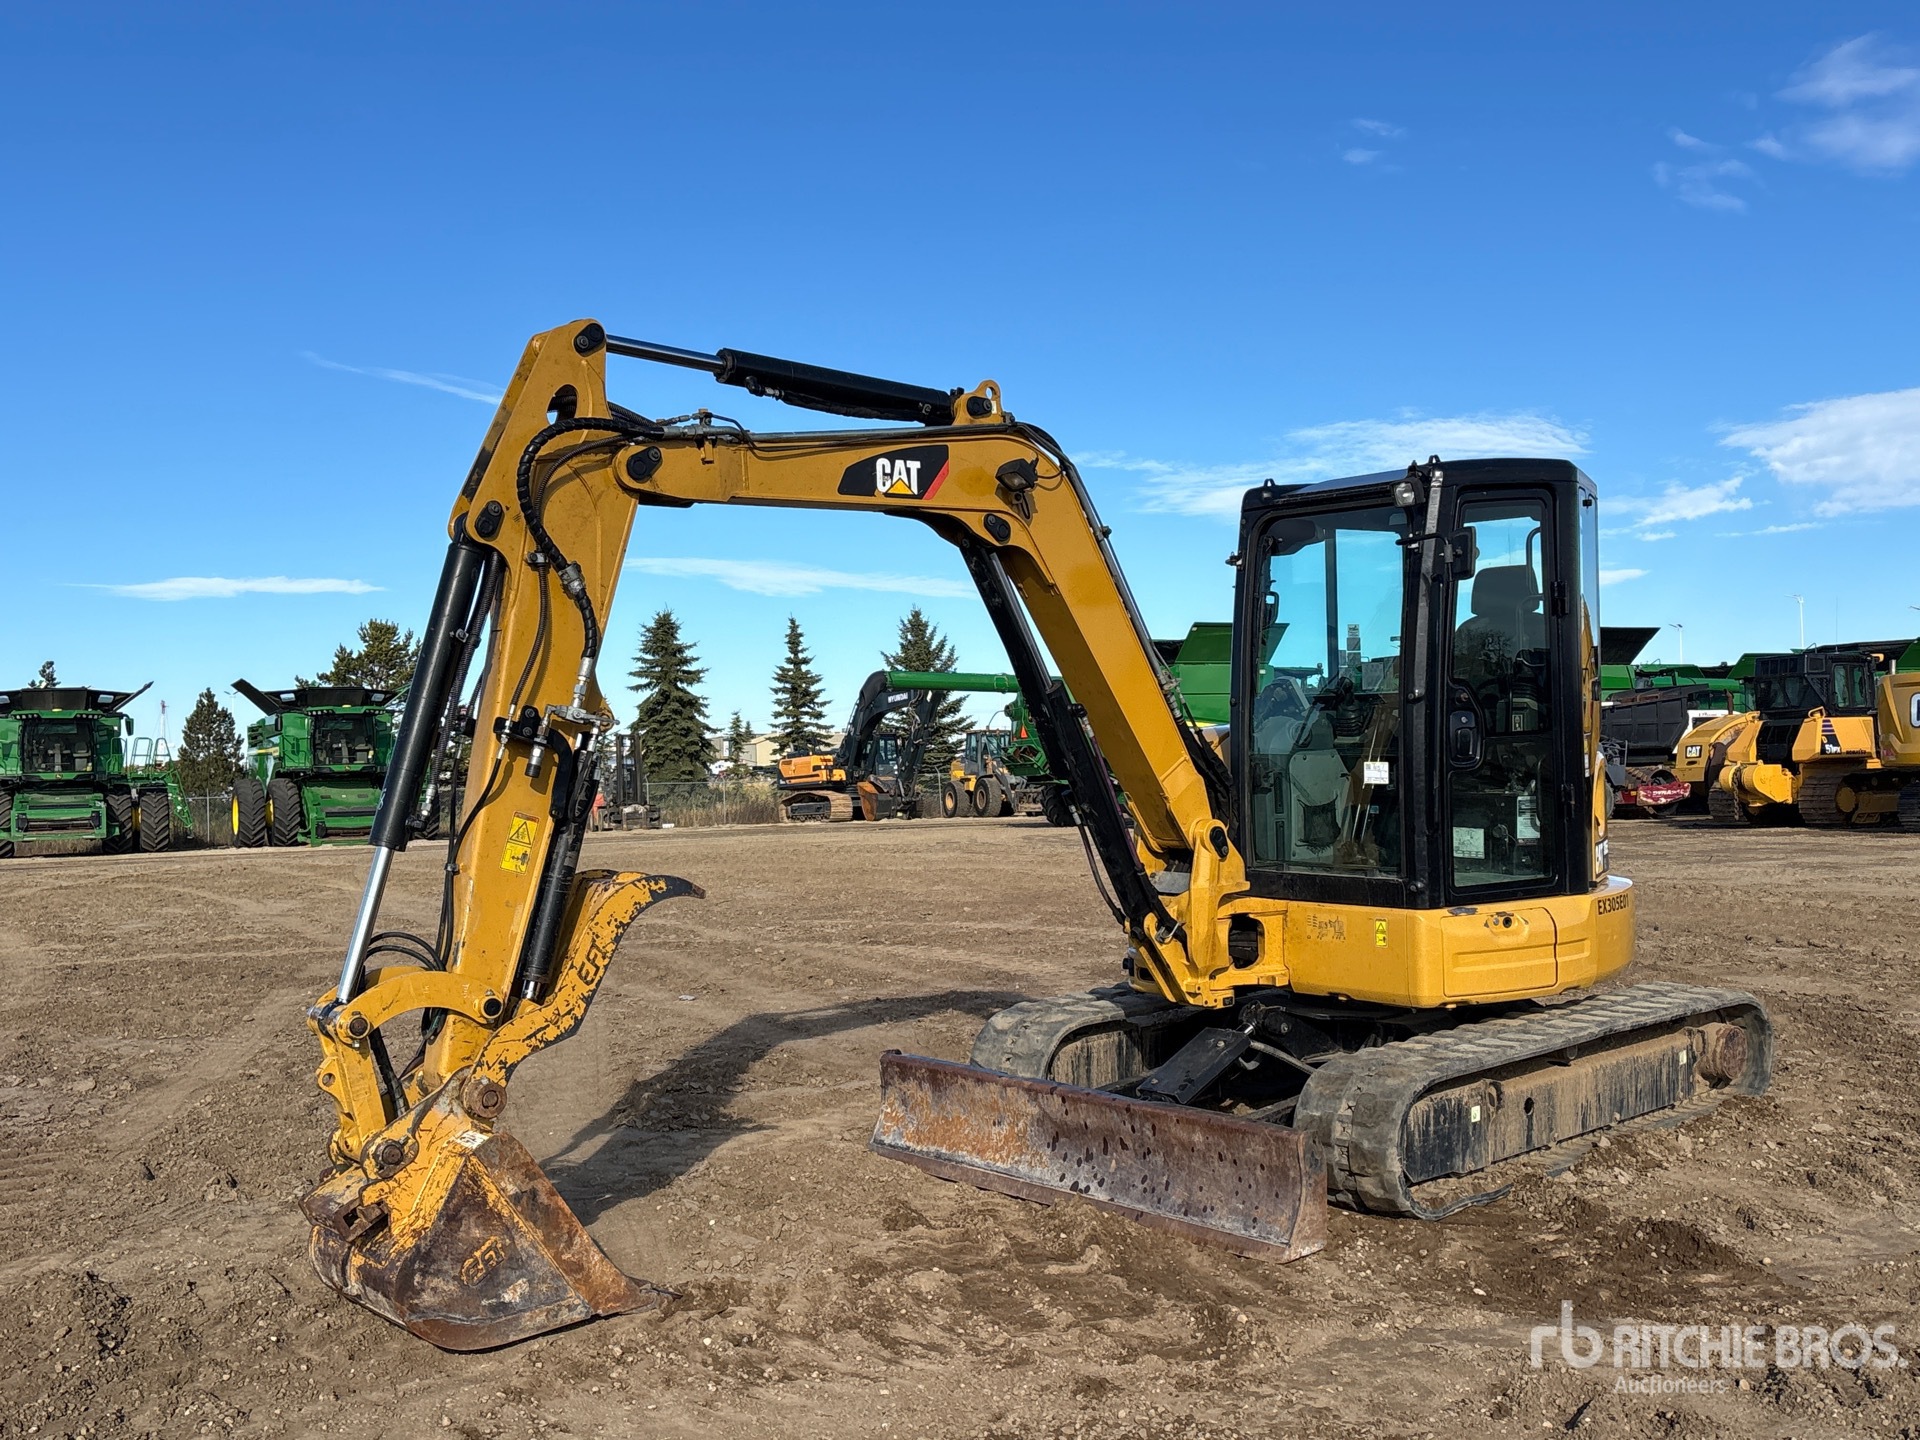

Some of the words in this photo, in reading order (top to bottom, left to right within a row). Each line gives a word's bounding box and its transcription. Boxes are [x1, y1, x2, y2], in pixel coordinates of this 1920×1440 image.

[875, 458, 921, 495] CAT
[1687, 746, 1701, 758] CAT
[1597, 893, 1629, 915] EX305E01
